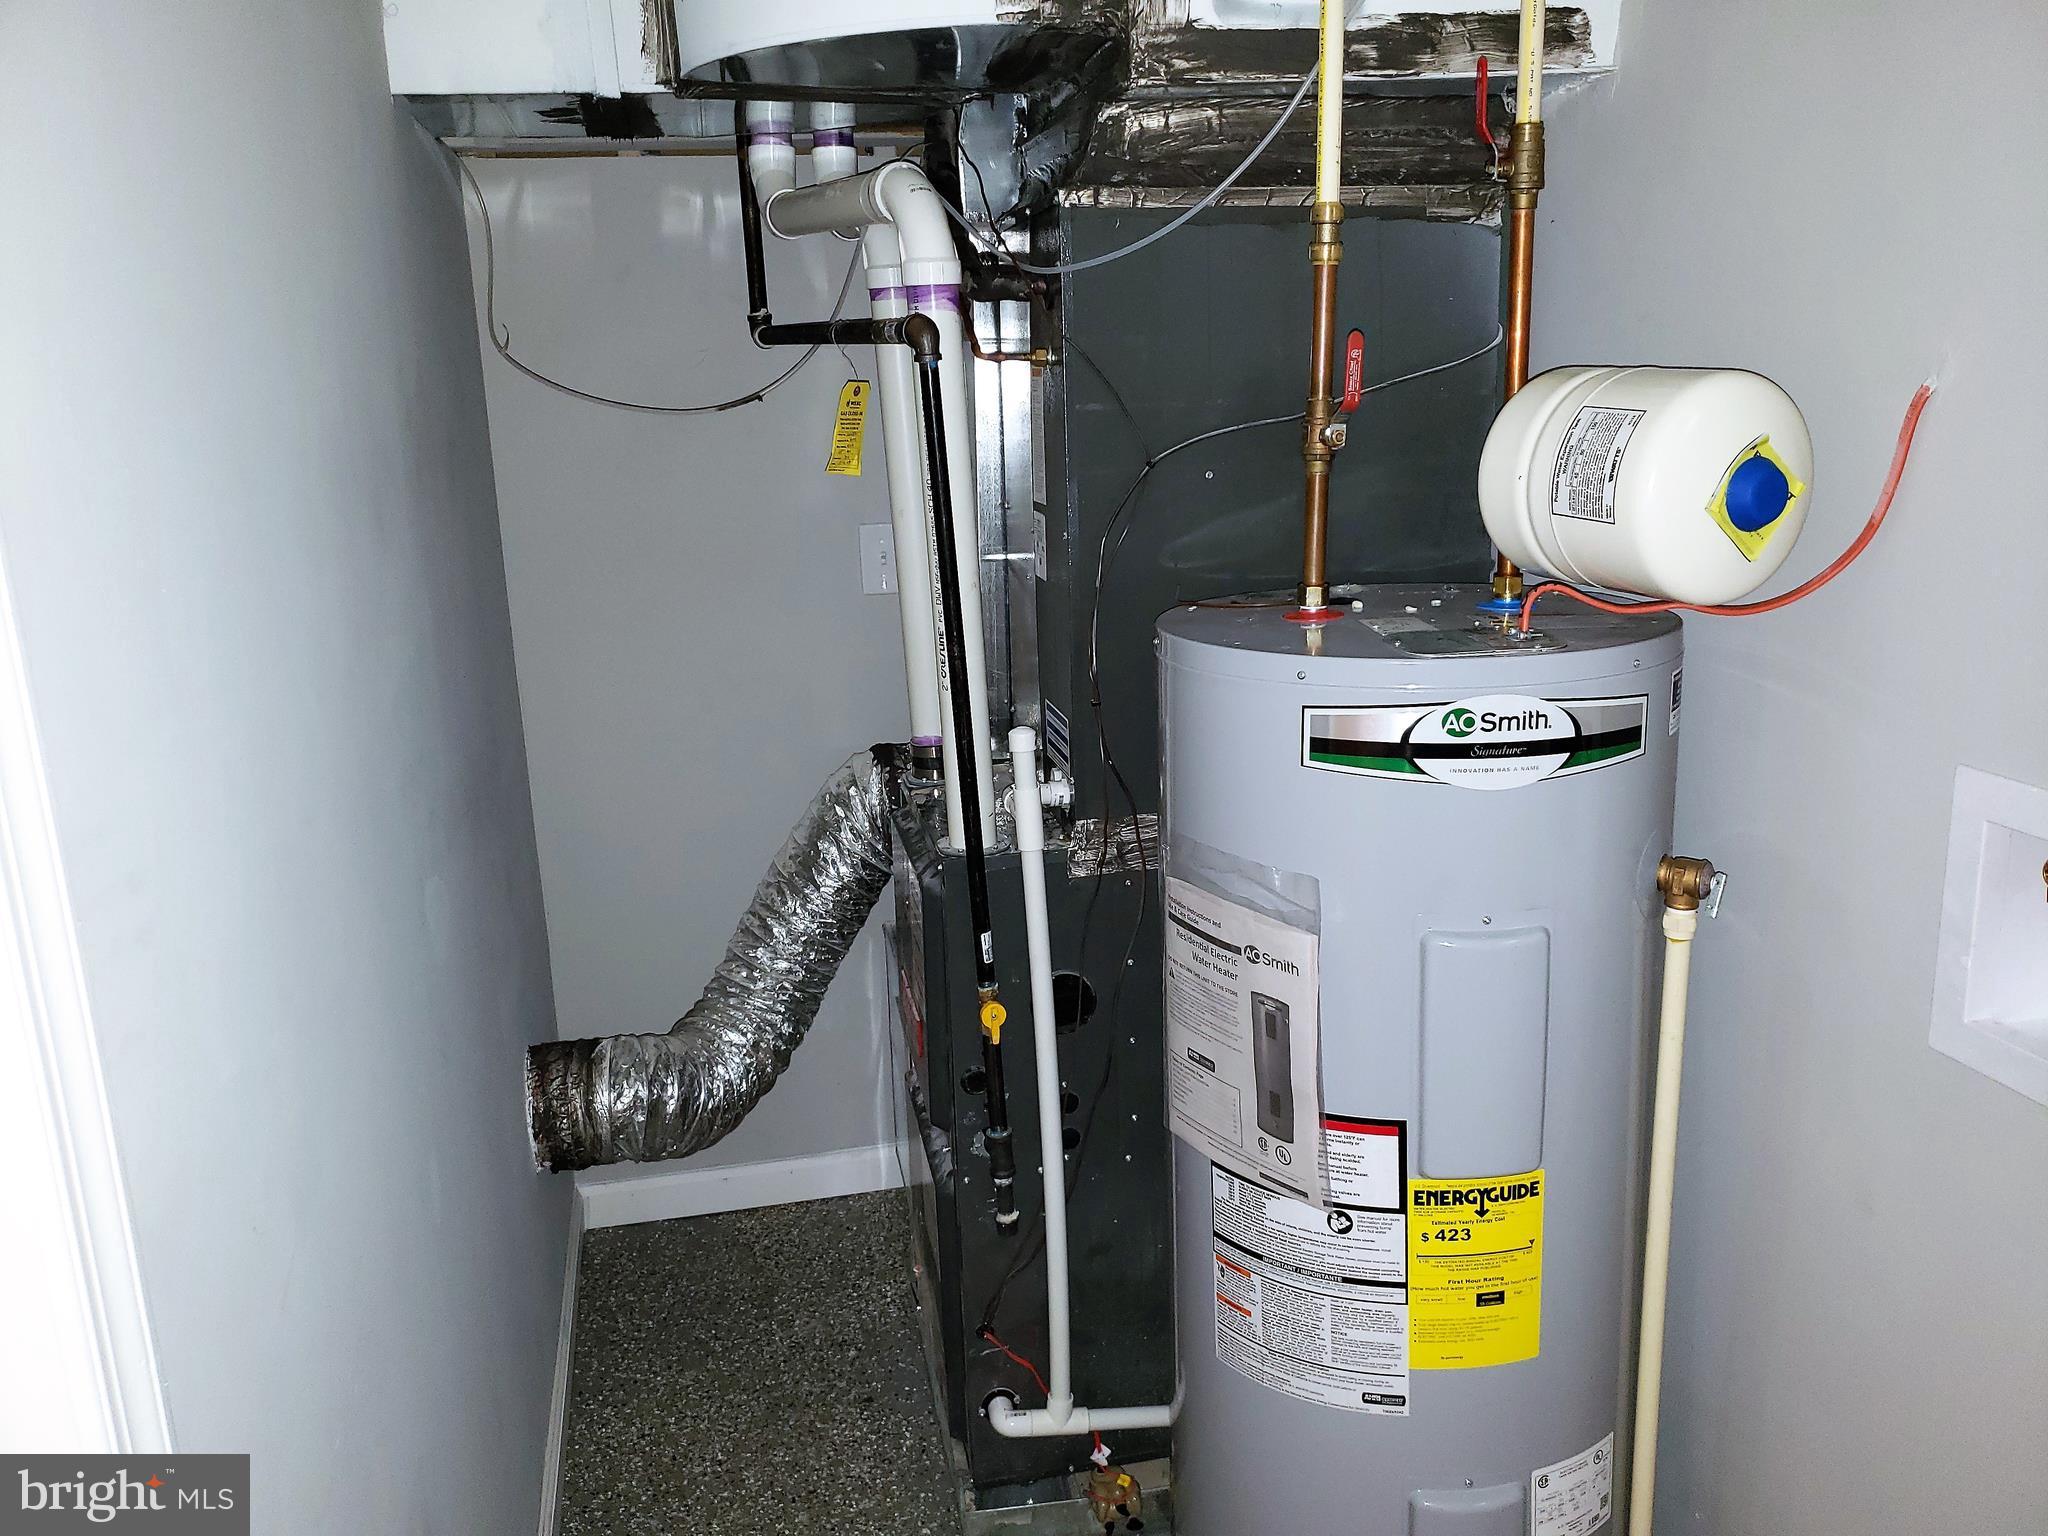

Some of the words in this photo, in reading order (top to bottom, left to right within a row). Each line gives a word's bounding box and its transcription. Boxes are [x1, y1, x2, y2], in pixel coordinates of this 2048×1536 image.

[1497, 765, 1511, 773] HAS
[1176, 928, 1209, 954] Residential
[1210, 947, 1238, 967] Electric
[1192, 951, 1212, 969] Water
[1213, 963, 1238, 980] Heater
[1262, 953, 1299, 976] Smith
[1421, 1231, 1429, 1243] $
[1434, 1228, 1472, 1242] 423
[1262, 1256, 1296, 1272] IMPORTANT
[1483, 1275, 1505, 1283] Rating
